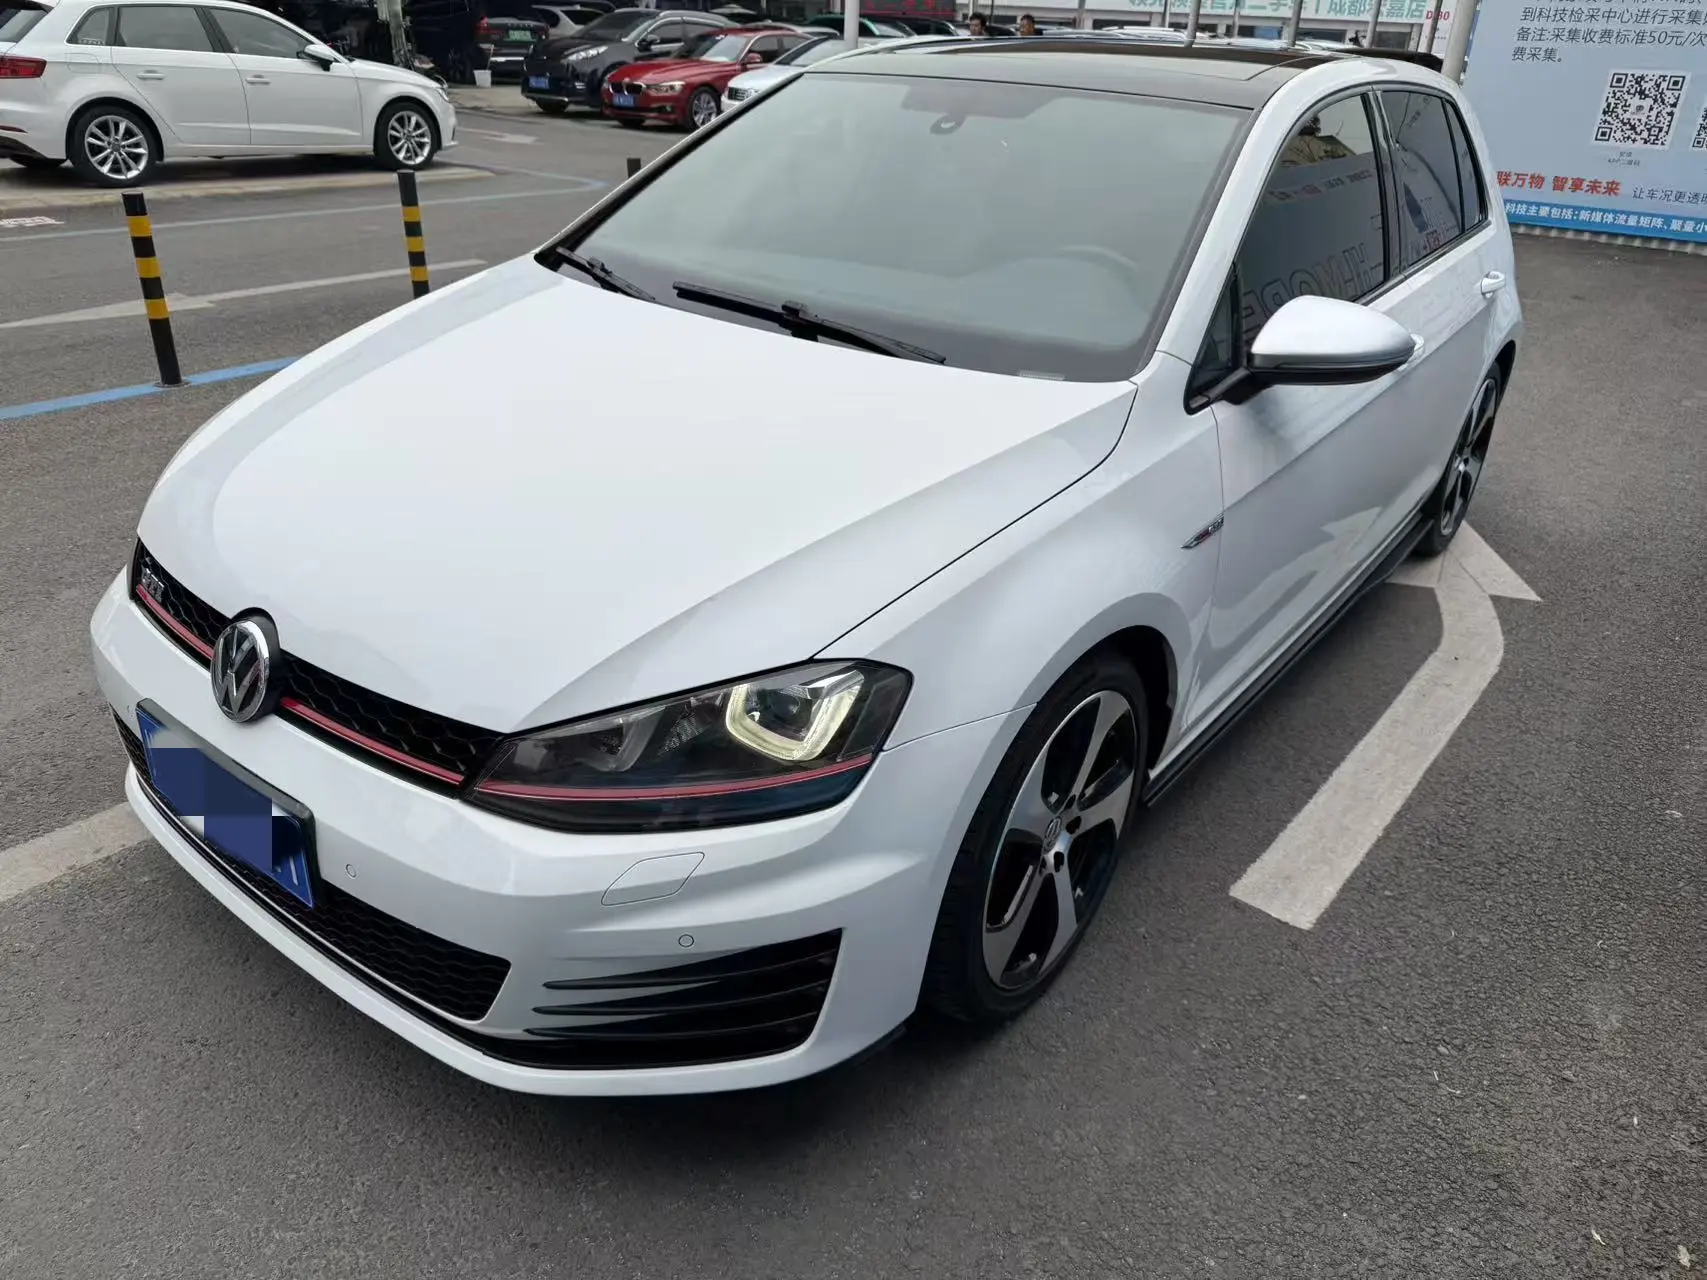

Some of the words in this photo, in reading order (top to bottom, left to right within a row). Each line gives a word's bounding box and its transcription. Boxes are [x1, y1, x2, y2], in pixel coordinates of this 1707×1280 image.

[1520, 7, 1707, 26] 到科技检采中心进行采集
[1511, 46, 1563, 63] 费采集。
[1552, 175, 1621, 197] 智享未来
